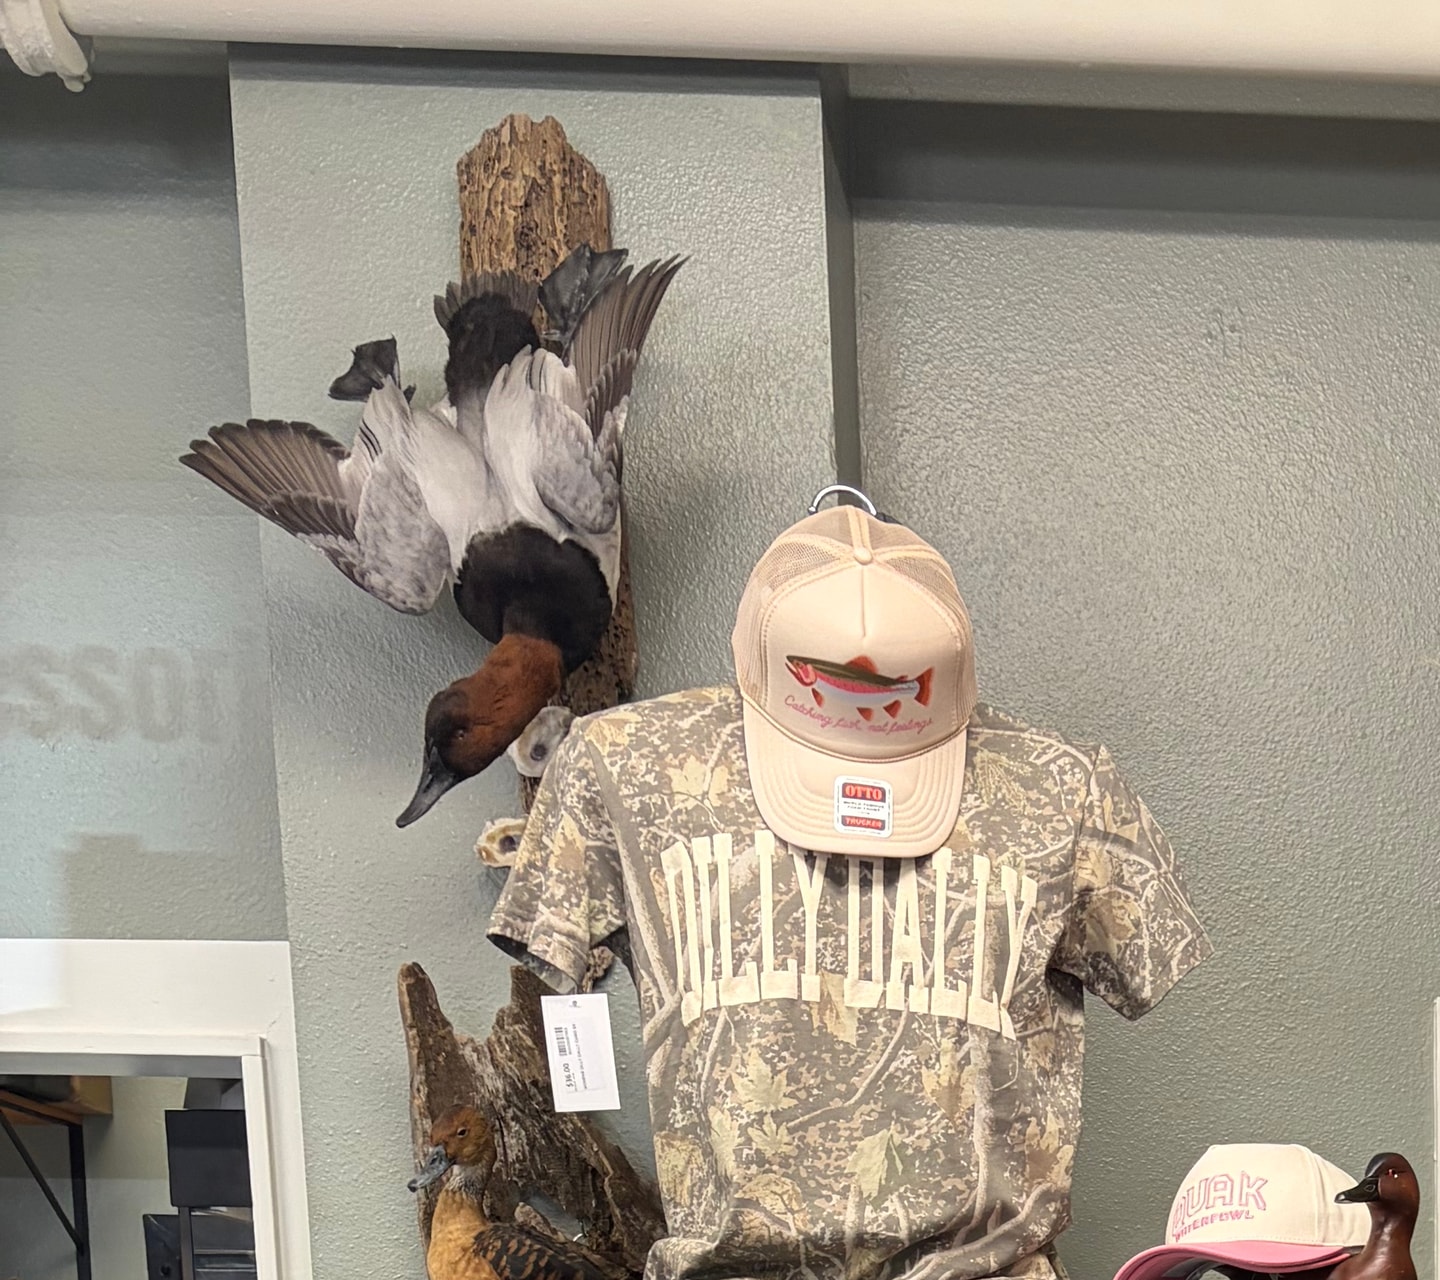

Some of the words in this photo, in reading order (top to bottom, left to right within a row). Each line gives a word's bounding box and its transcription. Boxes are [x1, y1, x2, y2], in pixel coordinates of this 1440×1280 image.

[785, 695, 832, 728] Catching
[845, 785, 882, 800] OTTO
[845, 817, 882, 829] TRUCKER
[563, 1063, 574, 1088] $36.00
